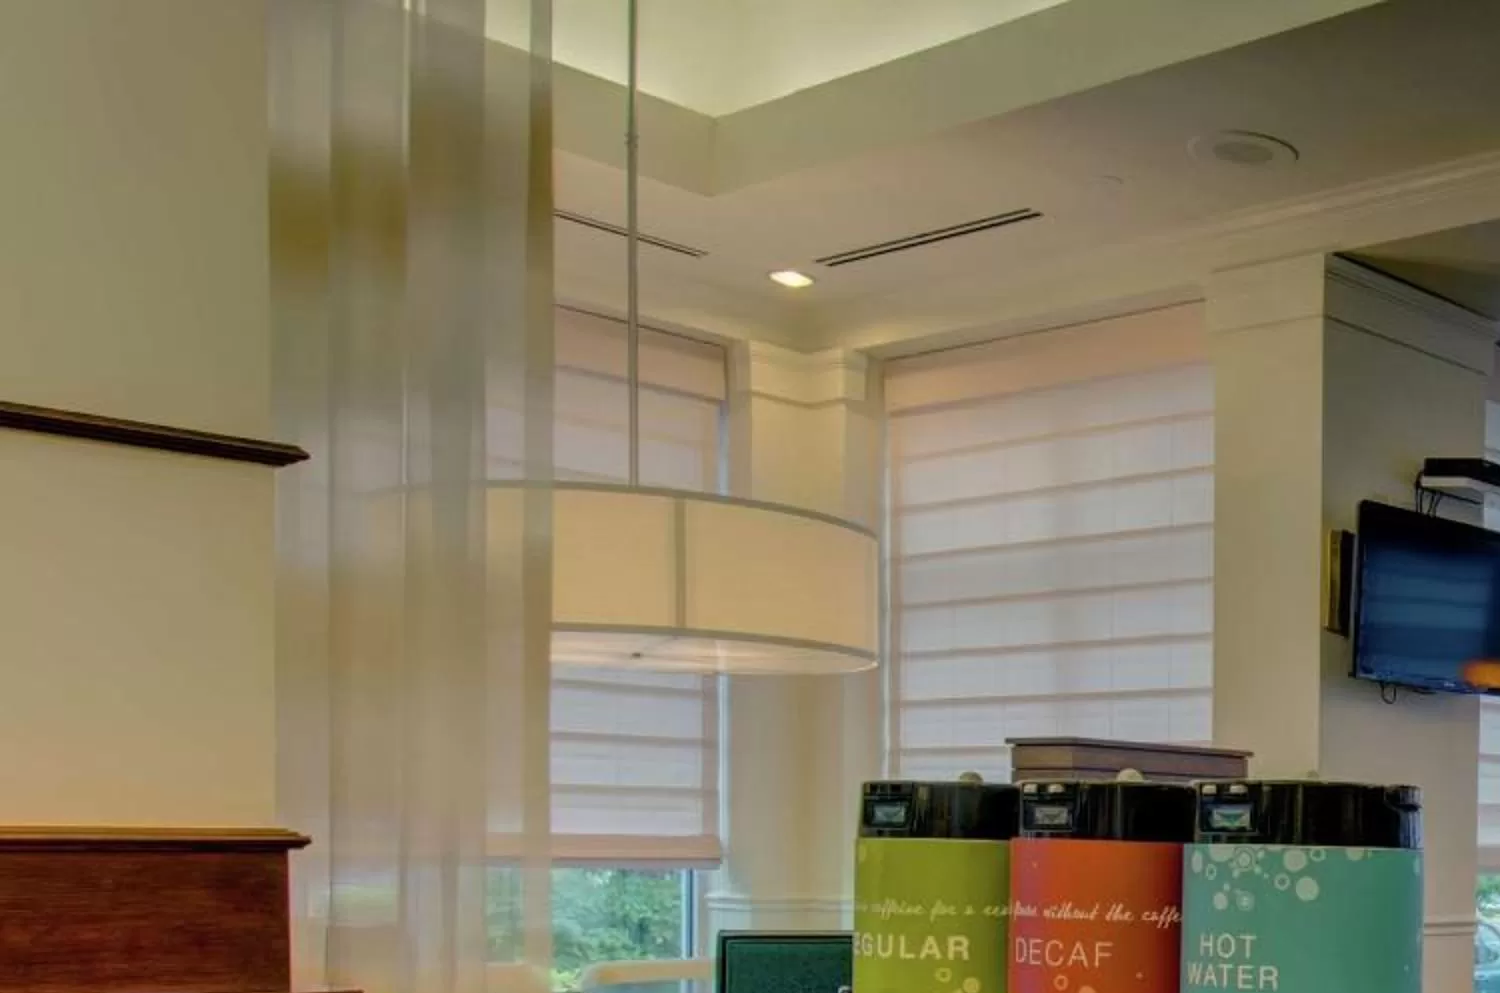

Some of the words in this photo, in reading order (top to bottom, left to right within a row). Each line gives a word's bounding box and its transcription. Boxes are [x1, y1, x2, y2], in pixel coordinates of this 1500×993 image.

[1043, 899, 1100, 921] without
[1104, 902, 1134, 922] the
[1015, 937, 1114, 968] DECAF
[1200, 932, 1257, 959] HOT
[1187, 962, 1279, 992] WATER
